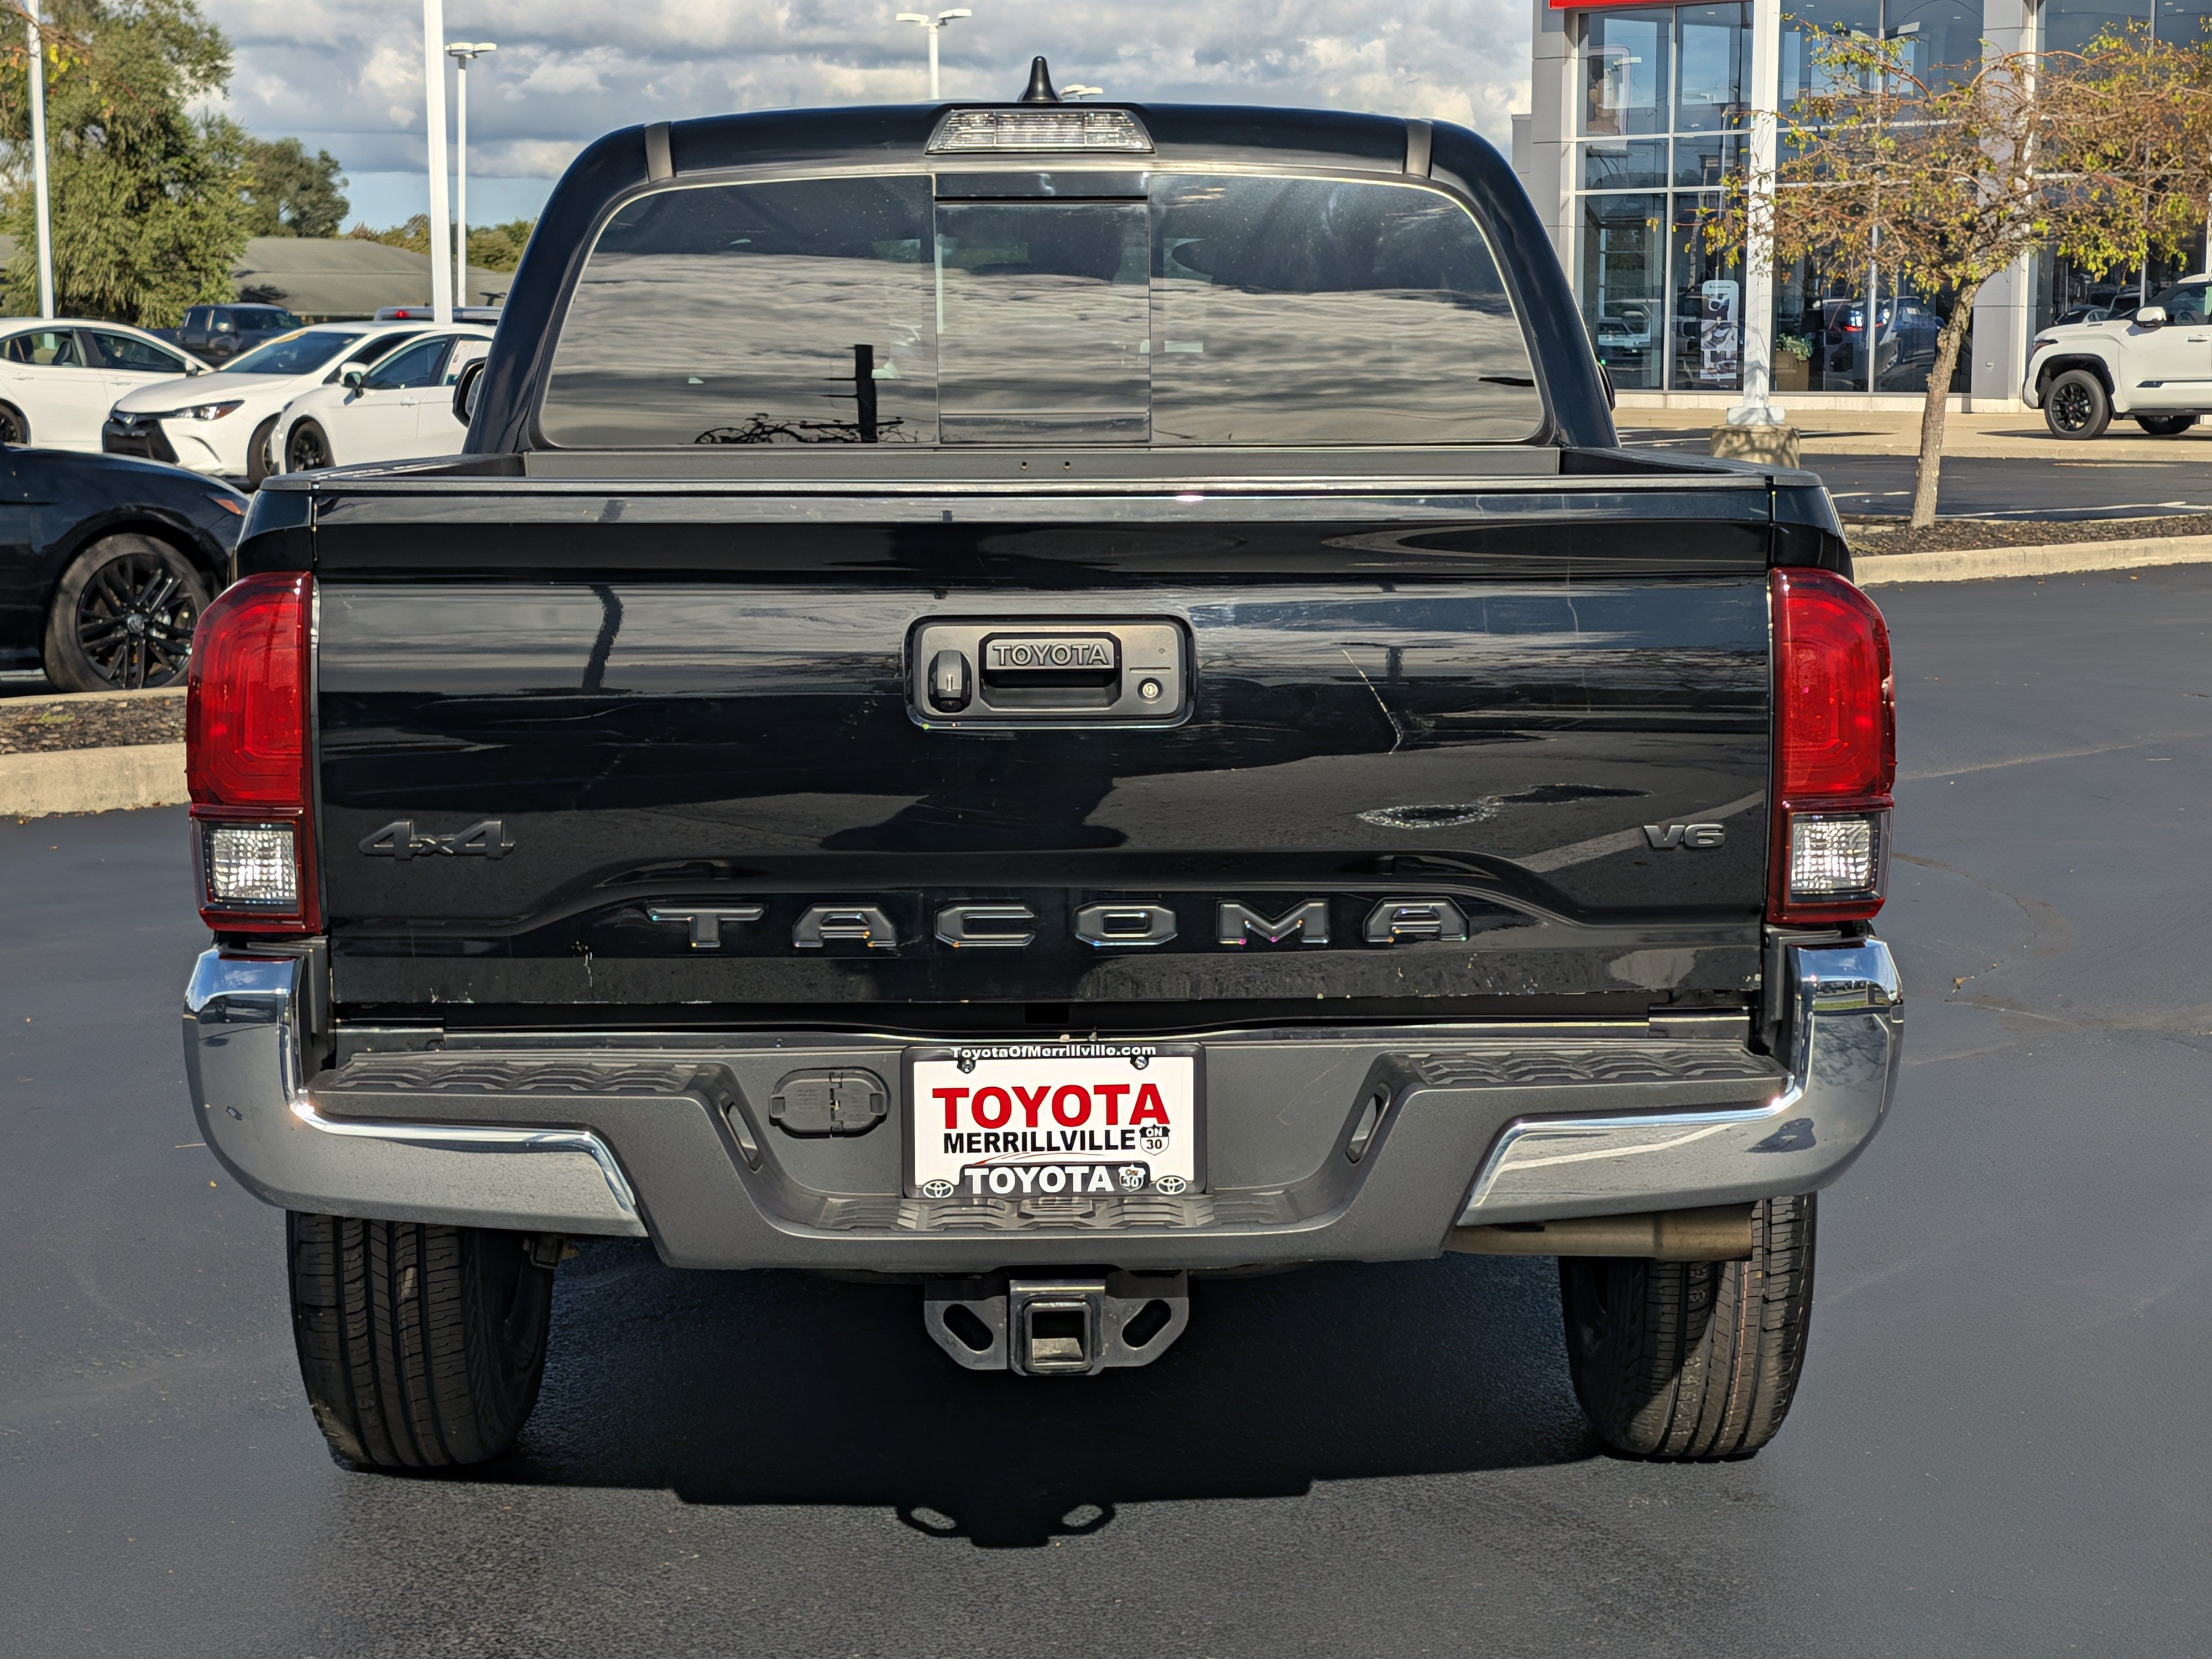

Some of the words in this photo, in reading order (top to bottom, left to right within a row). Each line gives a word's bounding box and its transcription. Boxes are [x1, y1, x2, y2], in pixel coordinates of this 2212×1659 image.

[993, 643, 1109, 666] TOYOTA
[359, 819, 514, 860] 4x4
[1643, 823, 1726, 848] V6
[646, 897, 1469, 948] TACOMA
[950, 1045, 1156, 1060] ToyotaOfMerrillville.com
[932, 1083, 1170, 1129] TOYOTA
[943, 1129, 1135, 1154] MERRILLVILLE
[1145, 1128, 1162, 1137] ON
[1146, 1139, 1162, 1149] 30
[965, 1166, 1115, 1194] TOYOTA
[1122, 1176, 1139, 1188] 30
